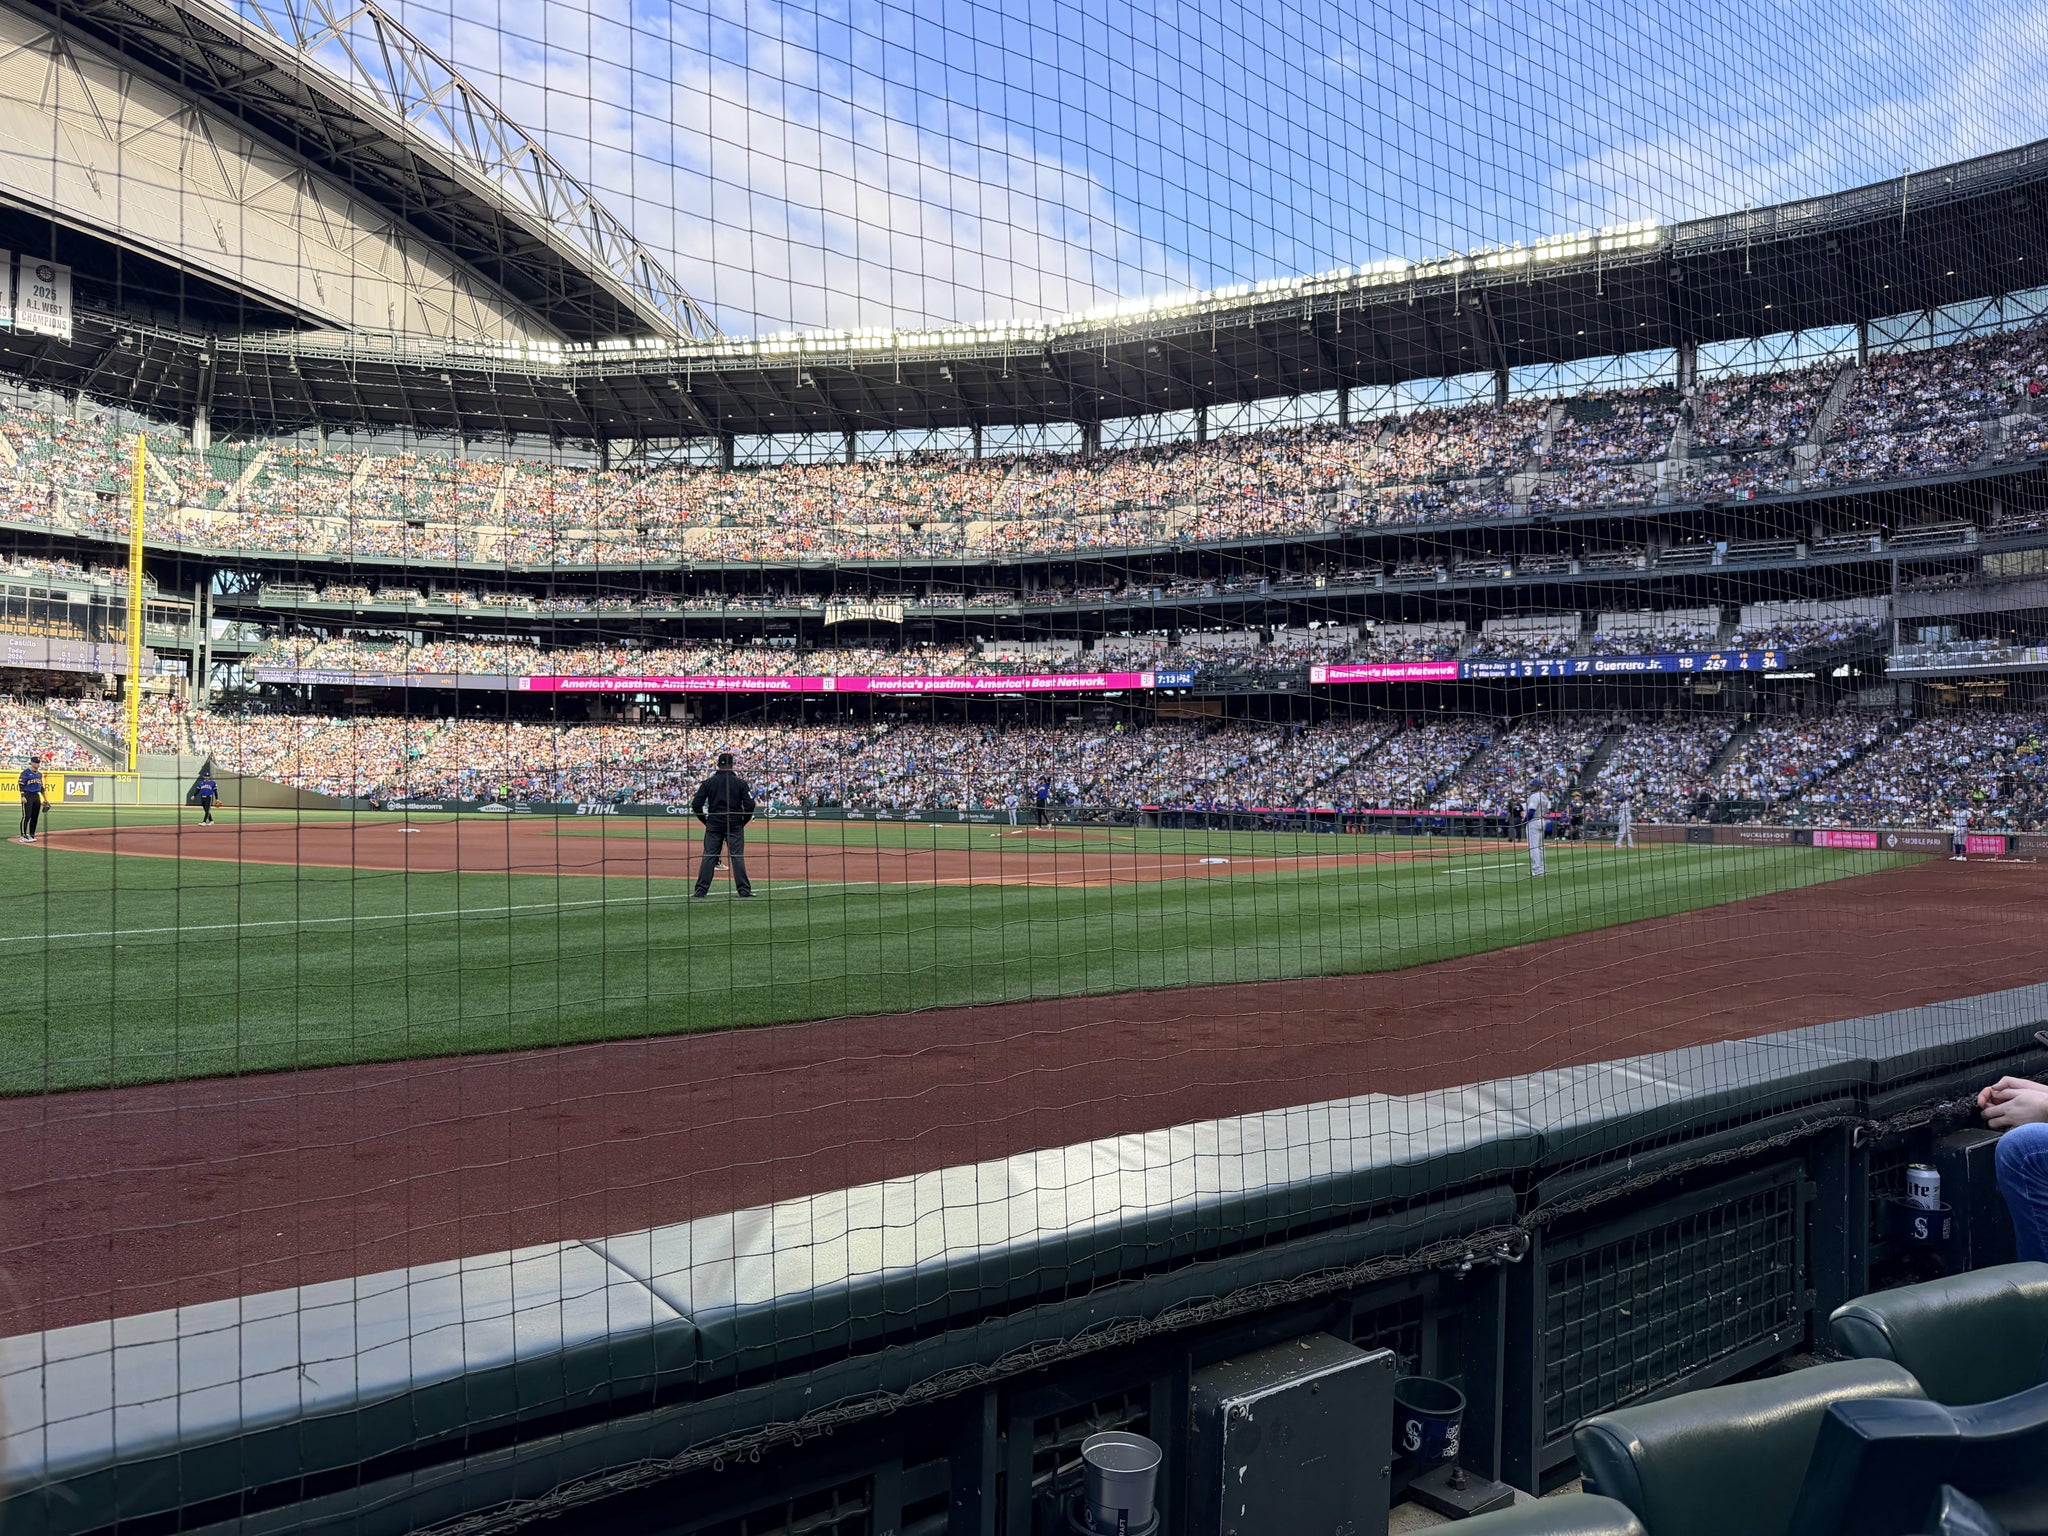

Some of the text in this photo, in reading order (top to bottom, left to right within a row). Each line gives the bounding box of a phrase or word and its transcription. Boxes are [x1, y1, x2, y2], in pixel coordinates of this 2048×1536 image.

[33, 285, 56, 300] 2025
[26, 298, 62, 315] A.L. WEST
[22, 311, 66, 330] CHAMPIONS
[876, 605, 903, 623] CLUB
[1575, 659, 1663, 671] 27 Guerrero Jr.
[1679, 658, 1693, 668] 1B
[1702, 659, 1727, 670] .267
[1740, 659, 1748, 669] 4
[1762, 658, 1778, 668] 34
[1382, 667, 1405, 677] Best
[1407, 666, 1455, 676] Network
[1525, 666, 1532, 676] 3
[1541, 666, 1549, 676] 2
[1559, 666, 1564, 675] 1
[319, 676, 350, 684] $27,320
[925, 680, 974, 690] pastime.
[1031, 677, 1056, 688] Best
[1057, 676, 1107, 687] Network.
[1157, 674, 1190, 684] 7:13 PM
[614, 680, 660, 690] pastime.
[716, 680, 740, 688] Best
[742, 680, 791, 688] Network.
[66, 781, 93, 795] CAT
[576, 804, 619, 814] STIHL
[666, 806, 693, 814] Great
[1908, 1182, 1929, 1197] ite
